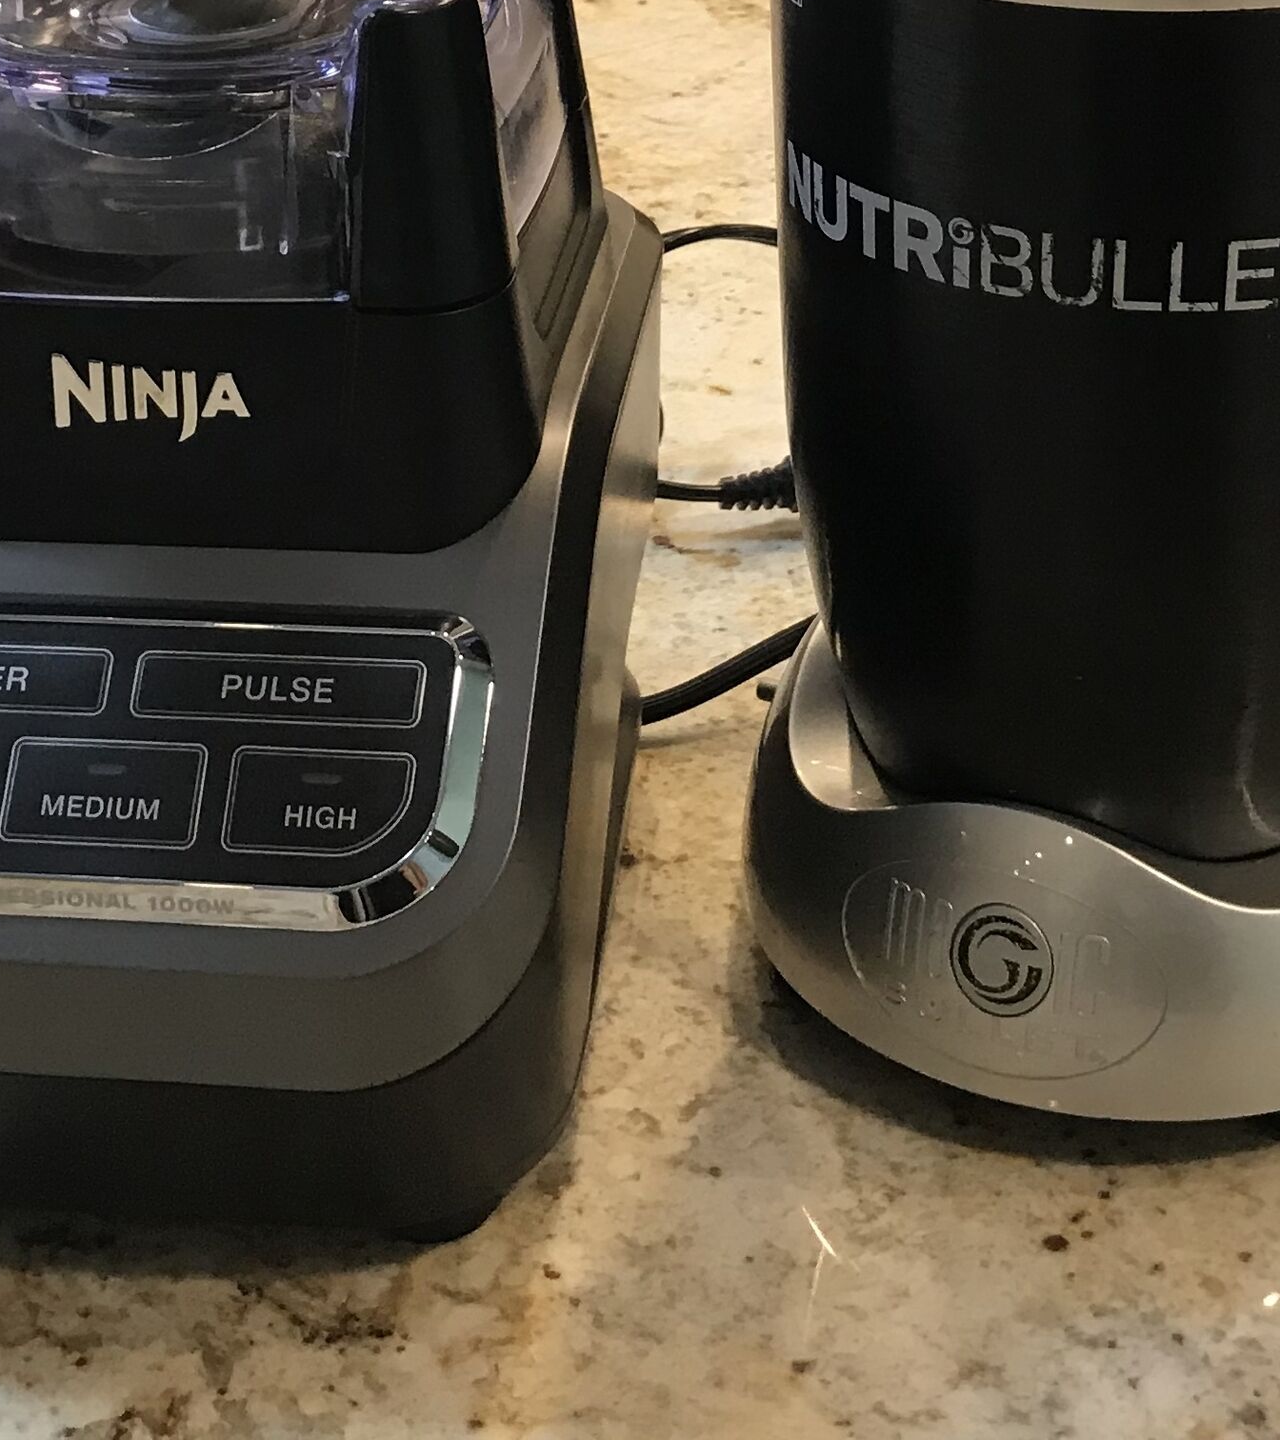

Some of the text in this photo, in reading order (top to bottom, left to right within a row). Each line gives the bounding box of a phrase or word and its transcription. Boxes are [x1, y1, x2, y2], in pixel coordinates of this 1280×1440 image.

[51, 353, 251, 442] NINJA
[221, 674, 334, 704] PULSE
[41, 794, 161, 821] MEDIUM
[284, 804, 357, 830] HIGH
[147, 896, 235, 914] 1000W
